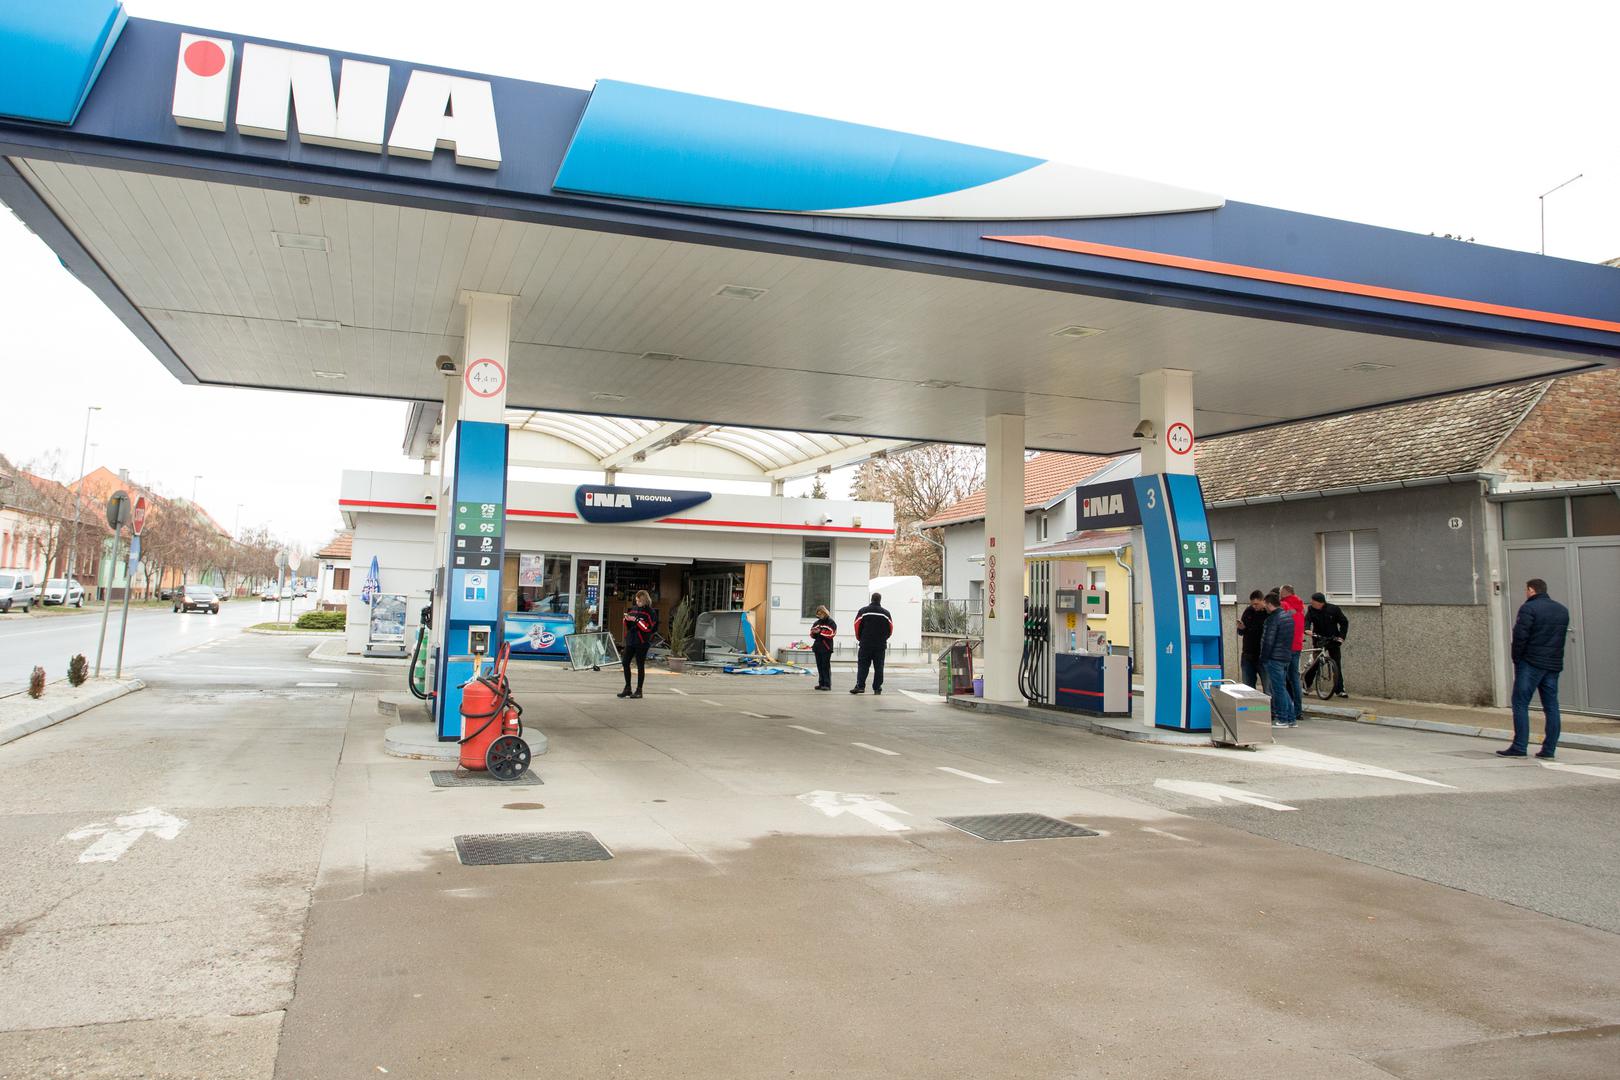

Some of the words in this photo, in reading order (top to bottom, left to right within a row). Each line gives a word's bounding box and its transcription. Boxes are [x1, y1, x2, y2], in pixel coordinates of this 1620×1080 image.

[635, 494, 672, 503] TRGOVINA
[1146, 488, 1156, 509] 3
[481, 504, 495, 512] 95
[480, 523, 494, 532] 95
[1451, 519, 1459, 528] 13
[482, 537, 492, 546] D
[480, 557, 491, 566] D
